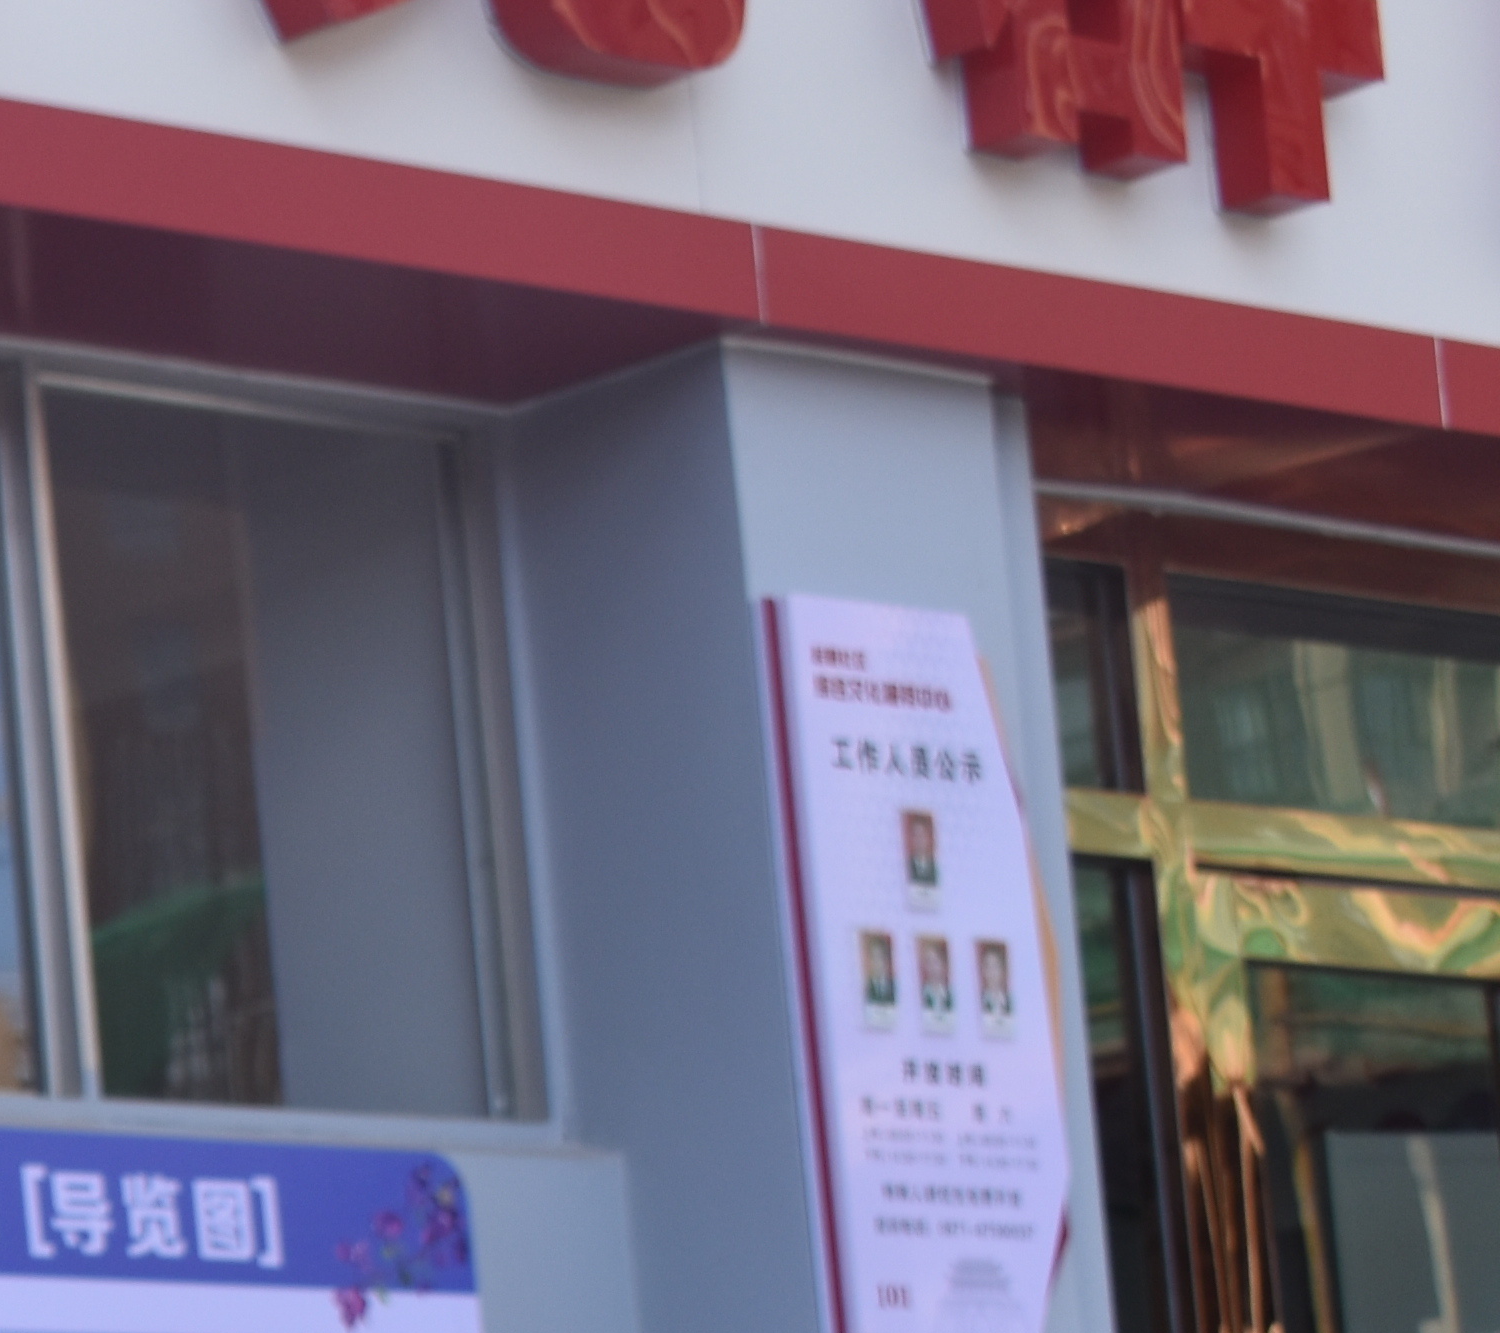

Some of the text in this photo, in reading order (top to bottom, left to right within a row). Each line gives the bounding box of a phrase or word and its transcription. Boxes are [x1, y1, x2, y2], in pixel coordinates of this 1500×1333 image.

[831, 737, 984, 784] 工作人员公示
